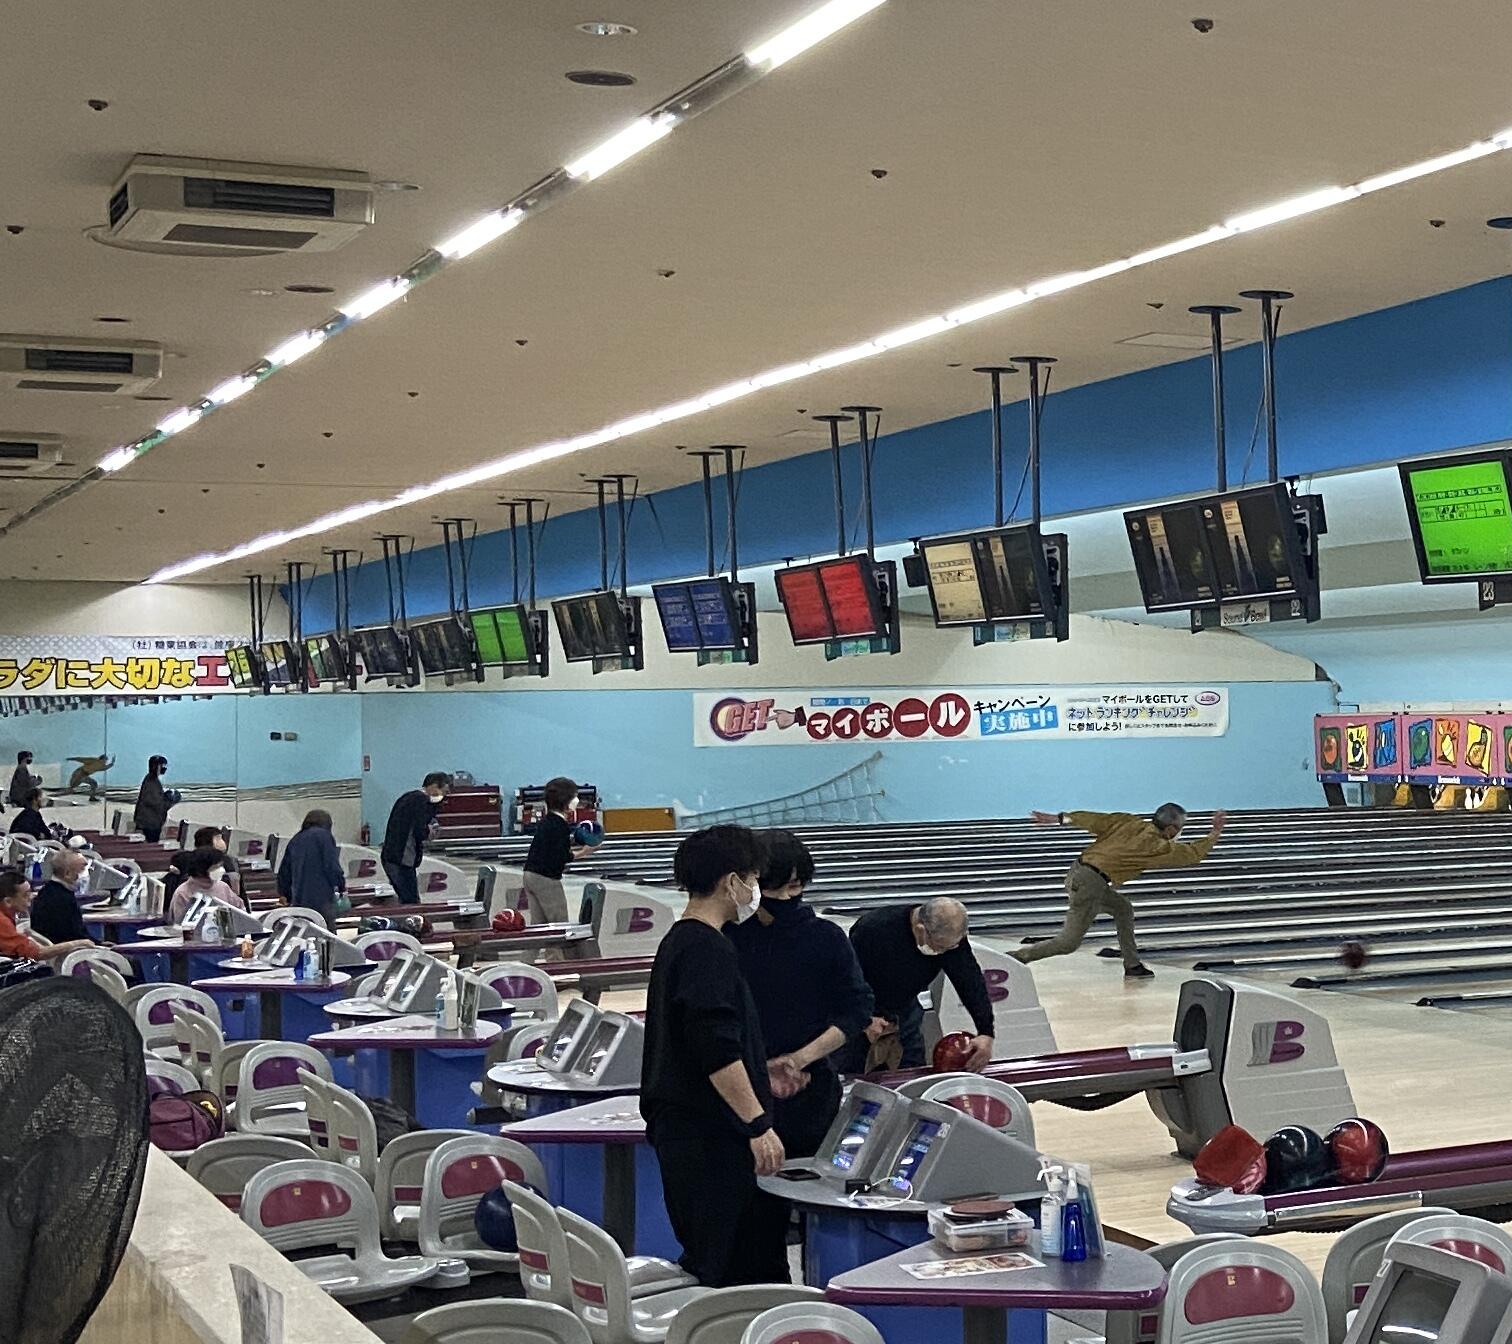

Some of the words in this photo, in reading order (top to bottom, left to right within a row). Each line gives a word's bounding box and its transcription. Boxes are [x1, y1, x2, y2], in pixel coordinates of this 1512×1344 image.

[973, 695, 1051, 714] キャンペーン
[1102, 694, 1189, 705] マイボールをGETして
[724, 698, 775, 736] GET
[808, 696, 968, 737] マイボール
[983, 708, 1055, 732] 実施中
